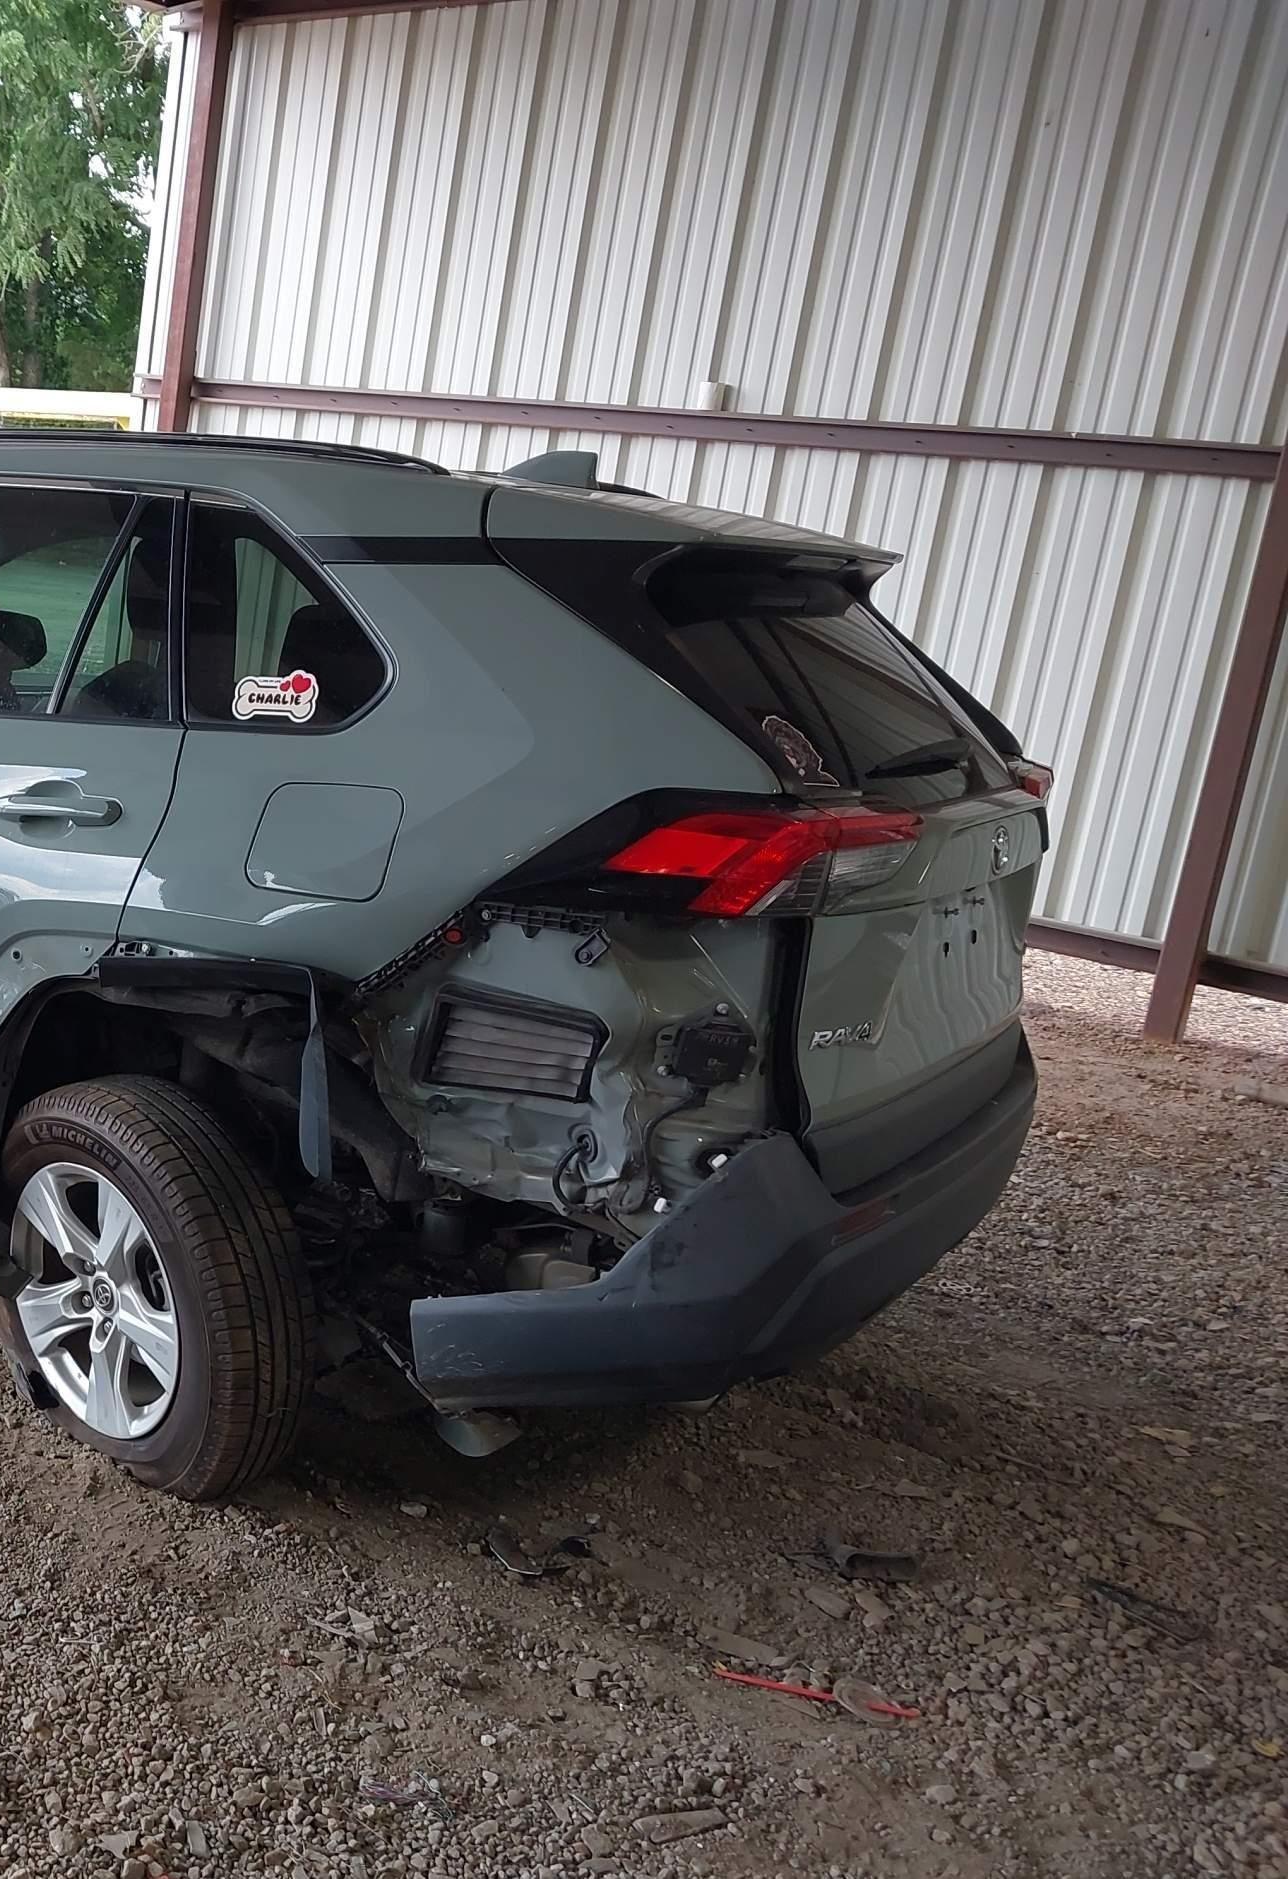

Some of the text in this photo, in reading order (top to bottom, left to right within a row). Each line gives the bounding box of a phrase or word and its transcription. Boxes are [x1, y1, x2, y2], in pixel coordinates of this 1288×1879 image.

[248, 693, 302, 706] CHARLIE
[809, 1021, 873, 1051] RAV4
[51, 1125, 119, 1169] MICHELIN
